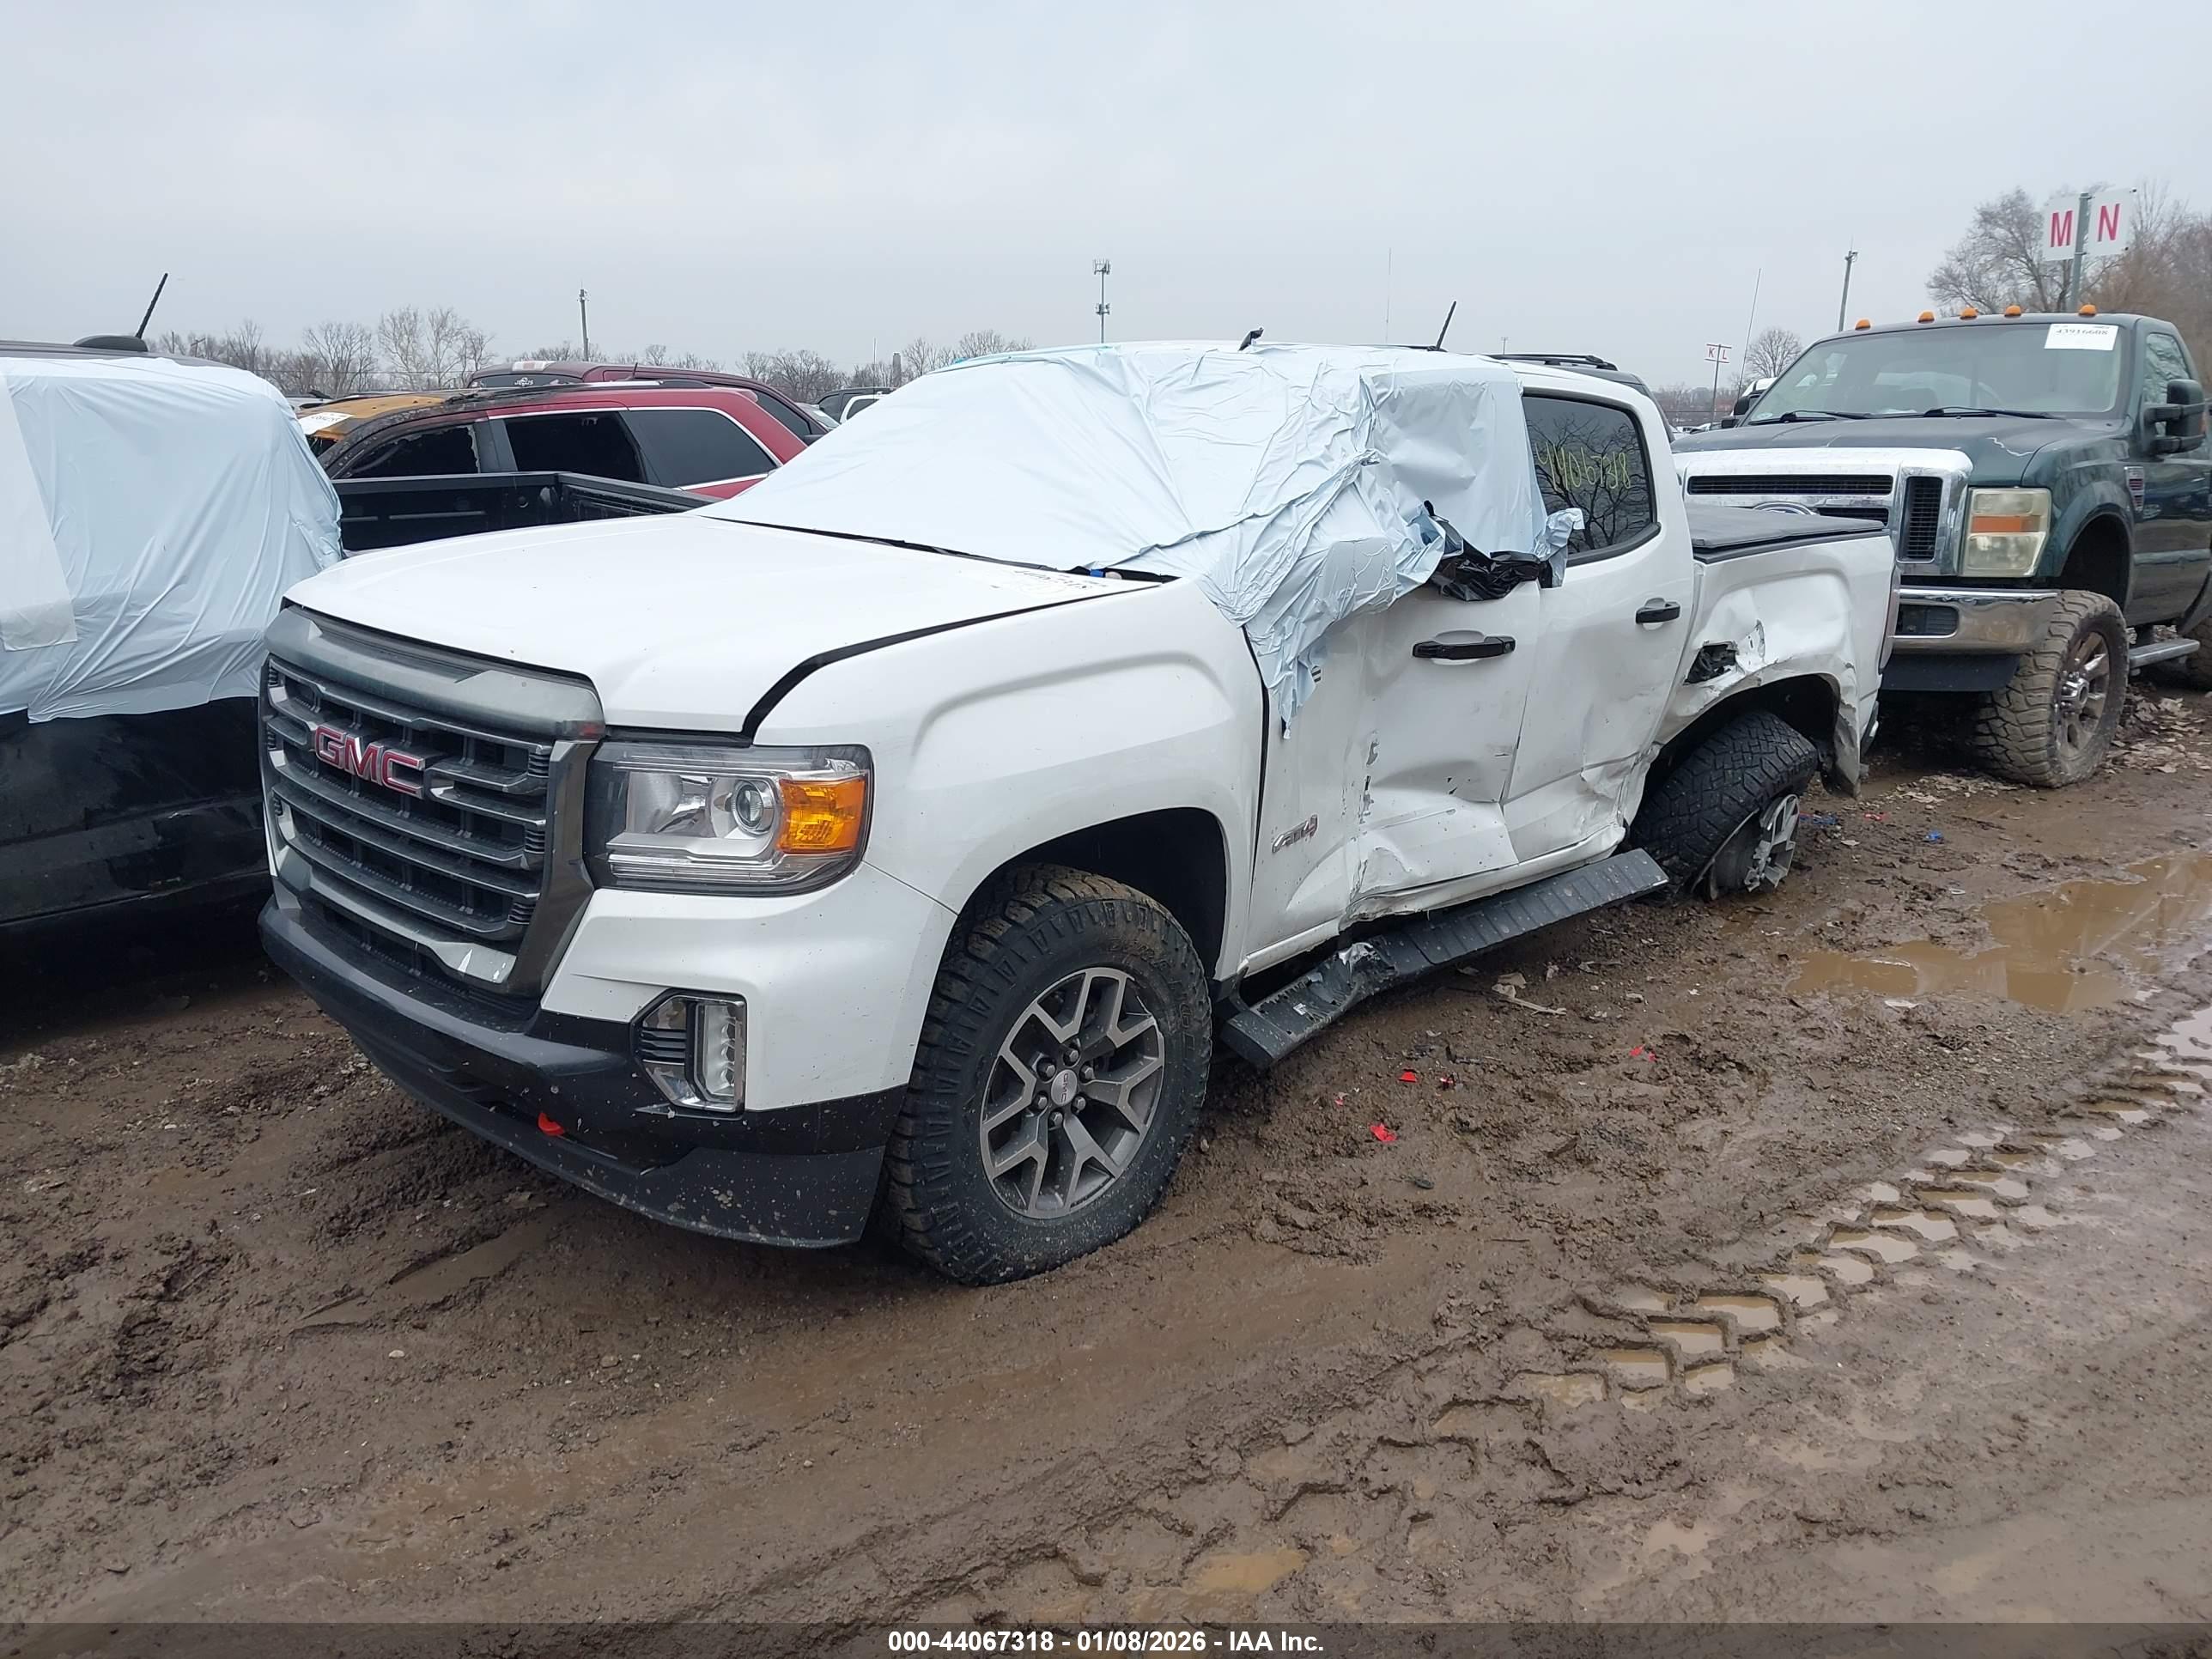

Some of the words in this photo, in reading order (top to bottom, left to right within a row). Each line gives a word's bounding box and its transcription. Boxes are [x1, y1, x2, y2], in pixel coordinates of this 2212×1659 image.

[2050, 210, 2074, 248] M
[2096, 203, 2121, 243] N
[1708, 347, 1716, 358] K
[1722, 349, 1728, 360] L
[314, 722, 426, 800] GMC
[1060, 1073, 1069, 1103] GMC
